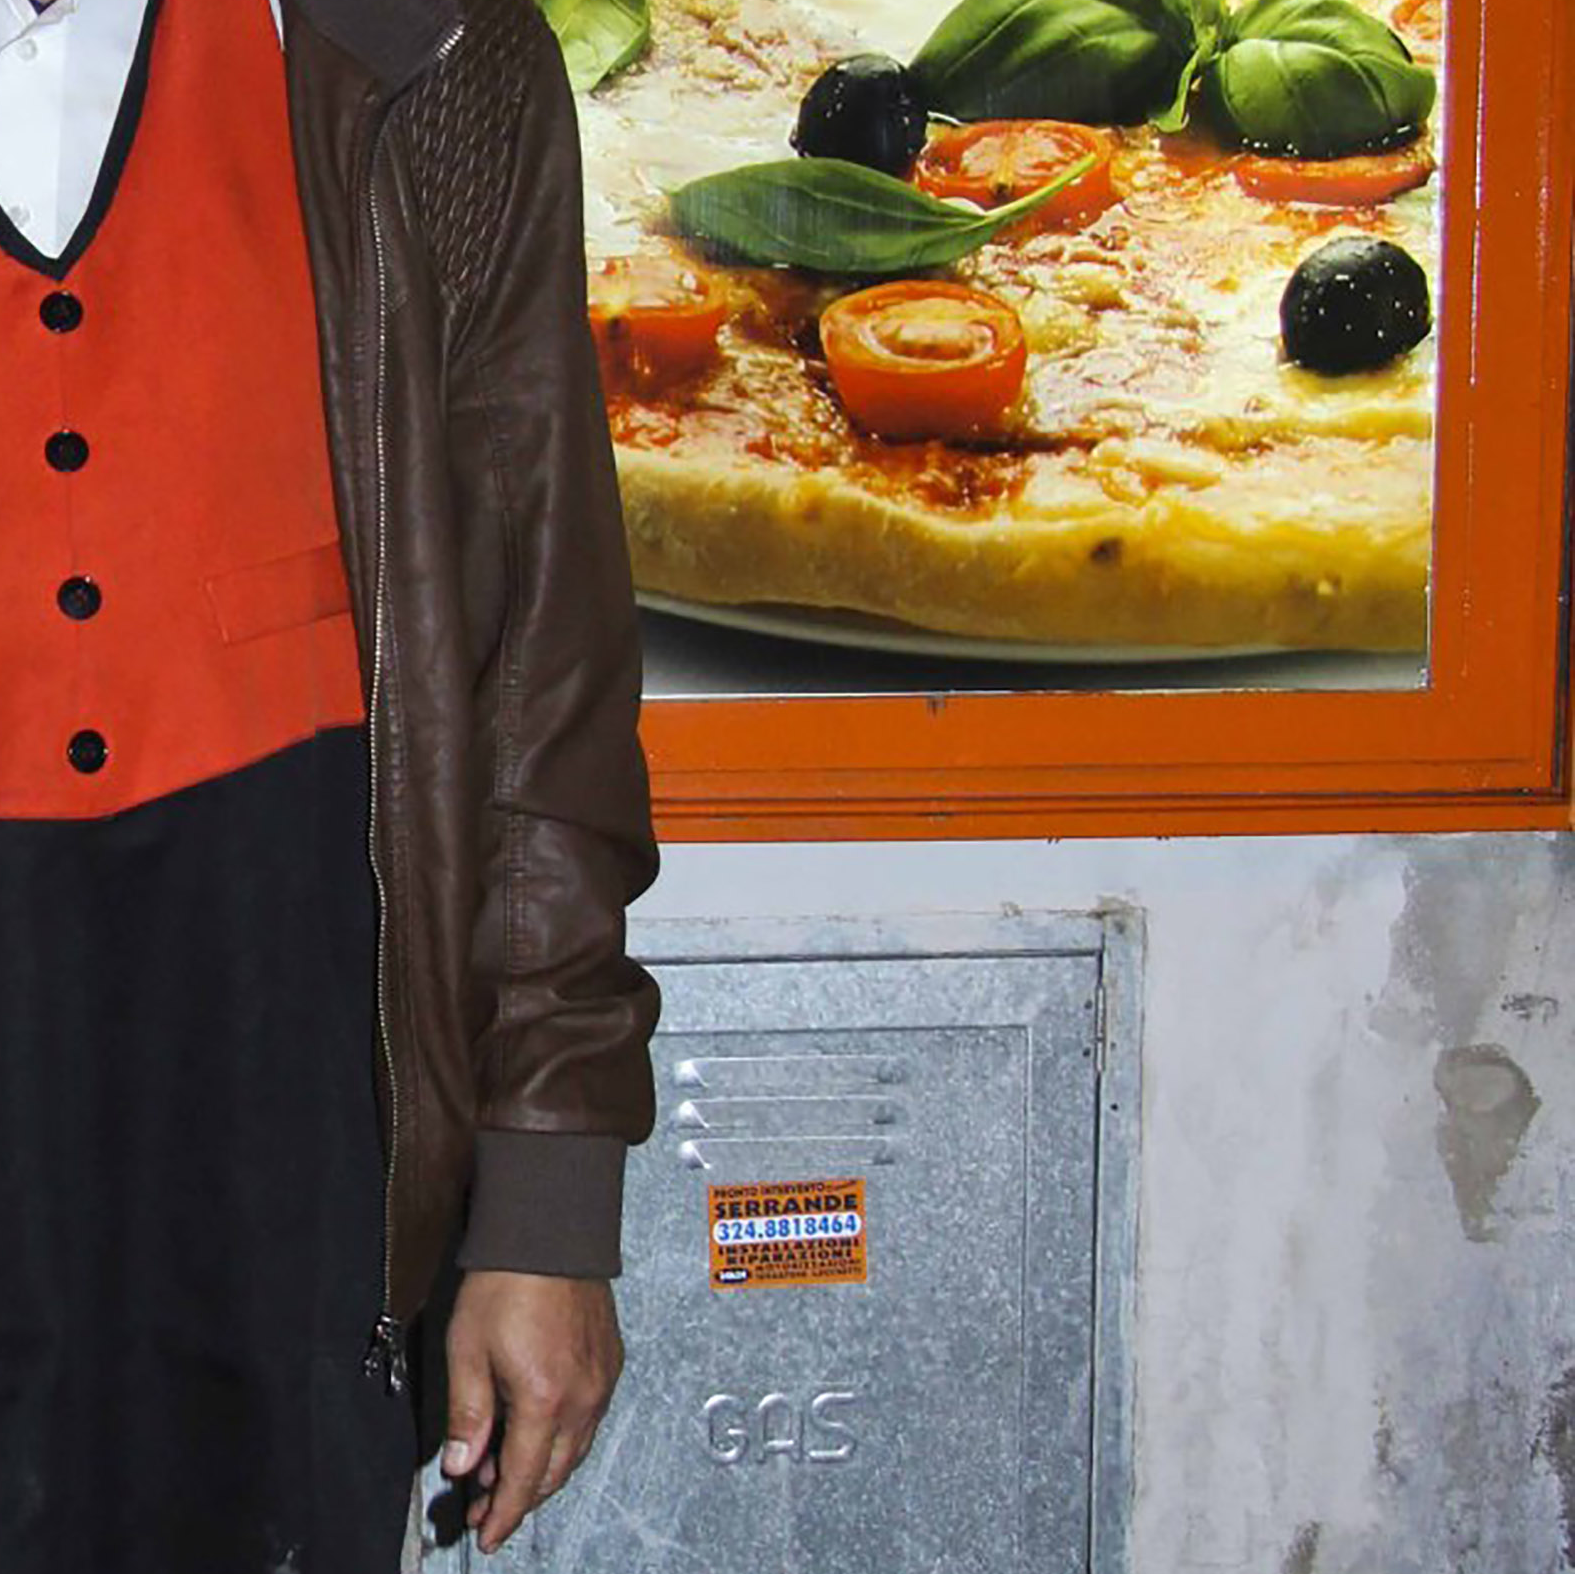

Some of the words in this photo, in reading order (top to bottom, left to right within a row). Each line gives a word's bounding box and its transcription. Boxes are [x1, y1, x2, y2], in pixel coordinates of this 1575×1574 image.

[715, 1193, 858, 1219] SERRANDE
[717, 1213, 857, 1241] 324.8818464
[718, 1237, 860, 1256] INSTALLAZIONI
[727, 1248, 853, 1265] RIPARAZIONI
[703, 1392, 858, 1465] GAS
